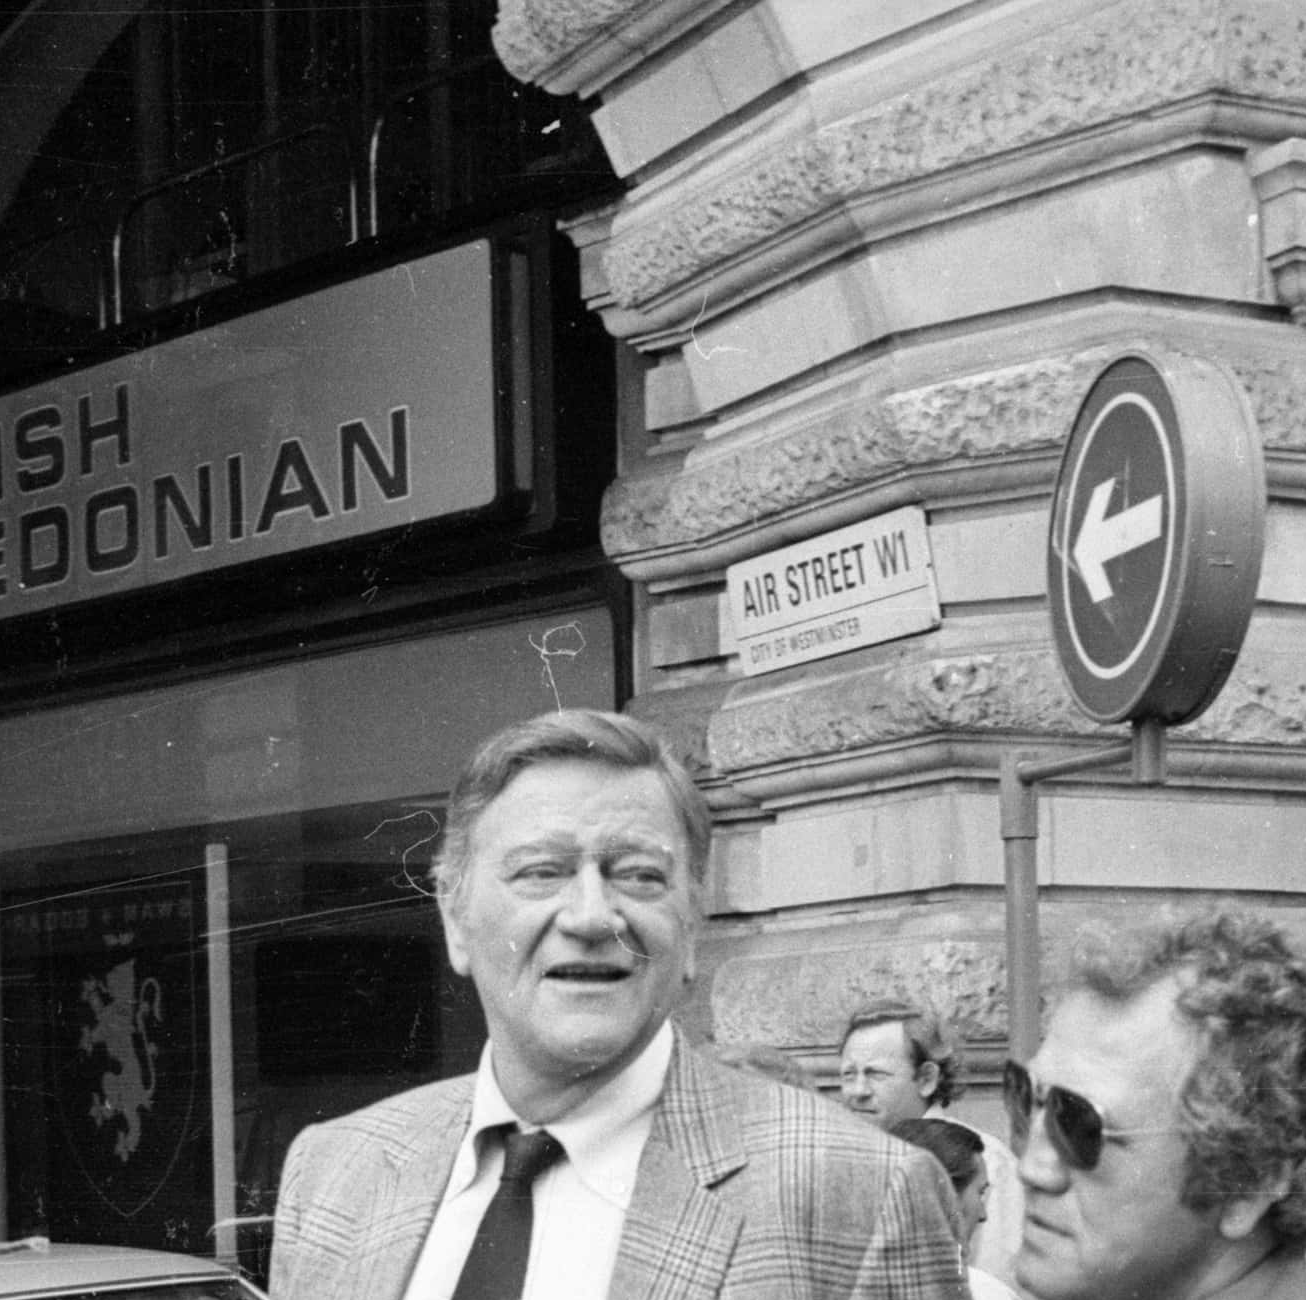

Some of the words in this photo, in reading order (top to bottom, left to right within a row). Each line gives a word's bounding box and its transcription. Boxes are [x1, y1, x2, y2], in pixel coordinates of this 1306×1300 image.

[743, 572, 781, 618] AIR
[785, 543, 866, 607] STREET
[873, 530, 911, 578] W1
